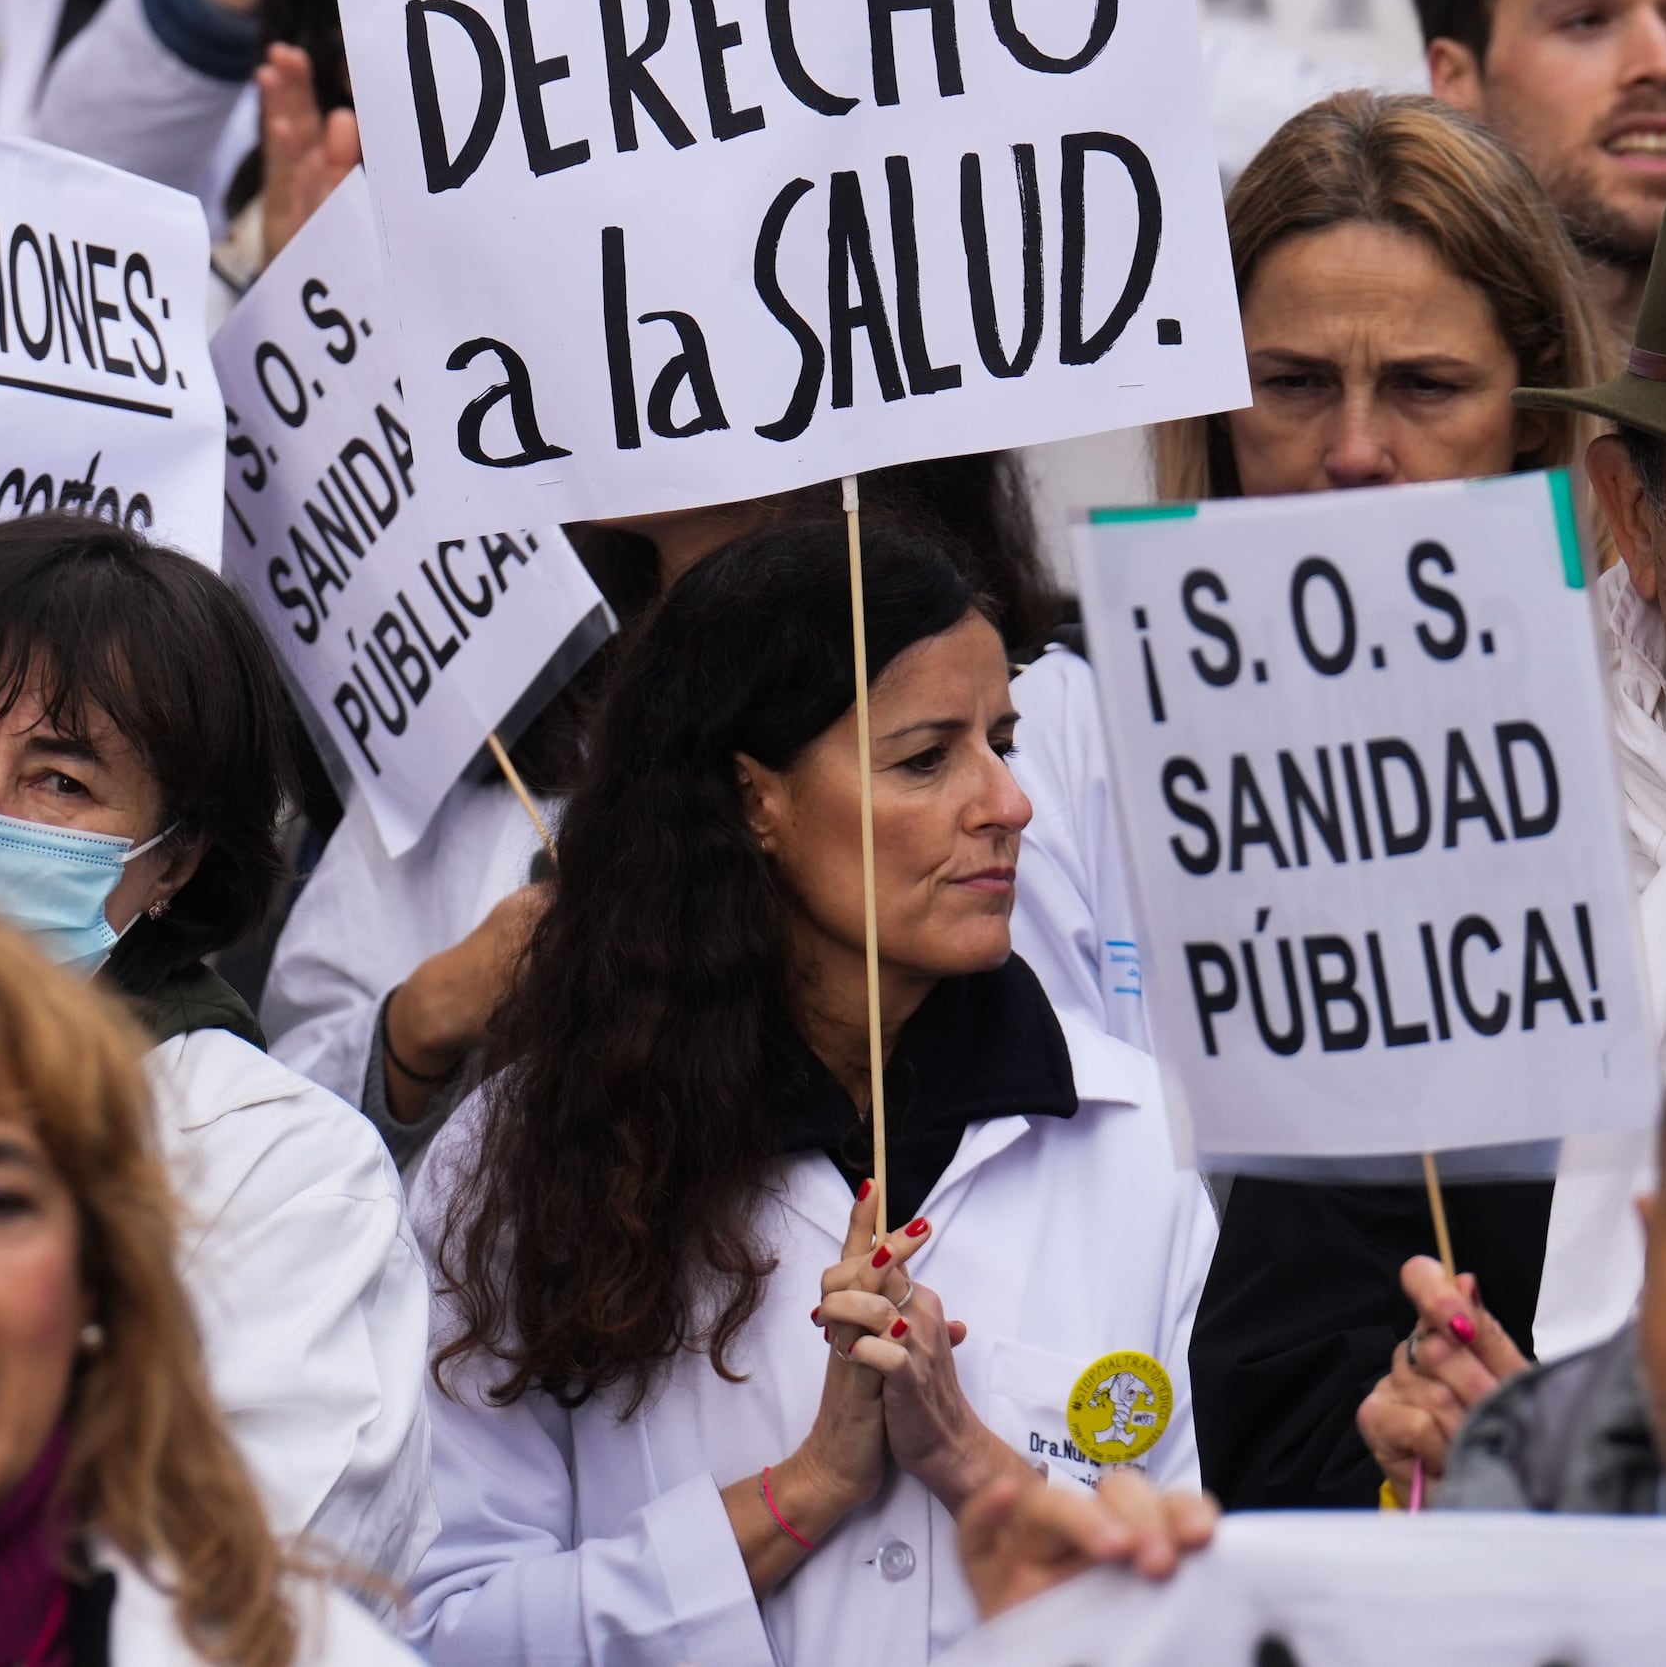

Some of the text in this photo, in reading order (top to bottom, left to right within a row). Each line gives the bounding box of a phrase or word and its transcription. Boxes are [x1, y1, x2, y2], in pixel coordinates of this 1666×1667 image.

[445, 131, 1183, 469] a la SALUD.
[268, 375, 416, 645] SANIDA
[1159, 720, 1561, 877] SANIDAD
[1184, 902, 1606, 1058] PÚBLICA!
